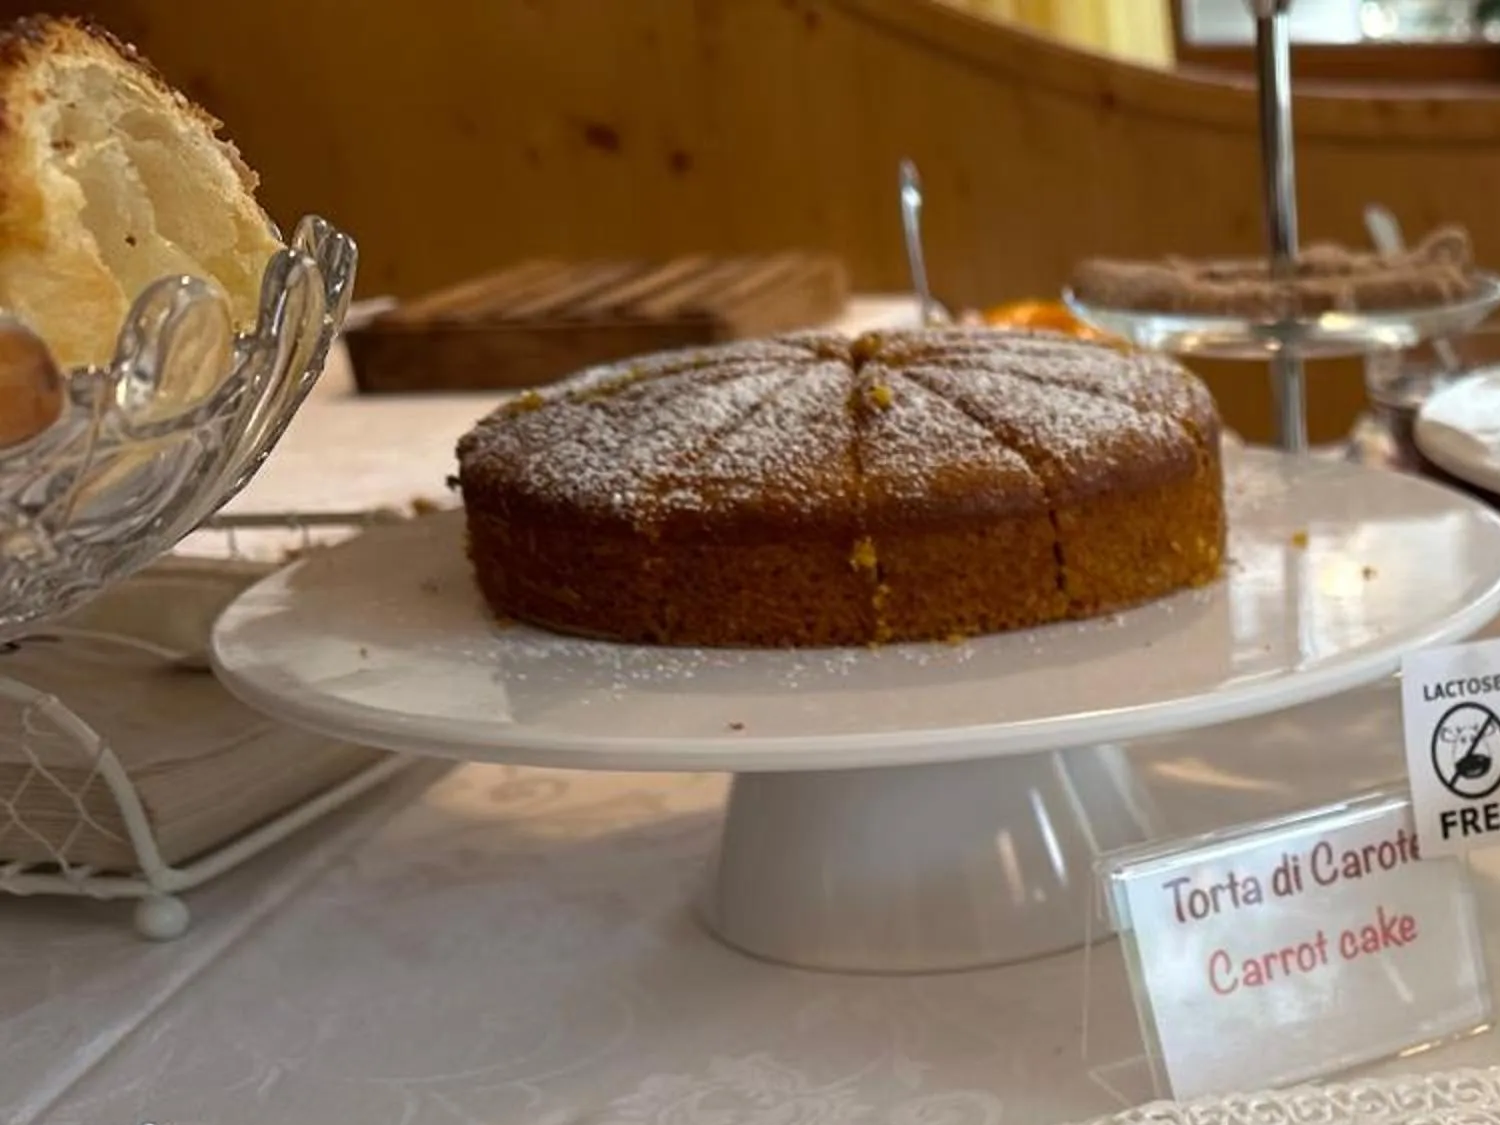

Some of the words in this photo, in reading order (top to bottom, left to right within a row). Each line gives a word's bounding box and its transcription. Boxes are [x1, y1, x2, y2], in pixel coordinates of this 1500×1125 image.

[1163, 873, 1263, 923] Torta
[1272, 853, 1303, 897] di
[1209, 930, 1329, 995] Carrot
[1340, 906, 1418, 960] cake
